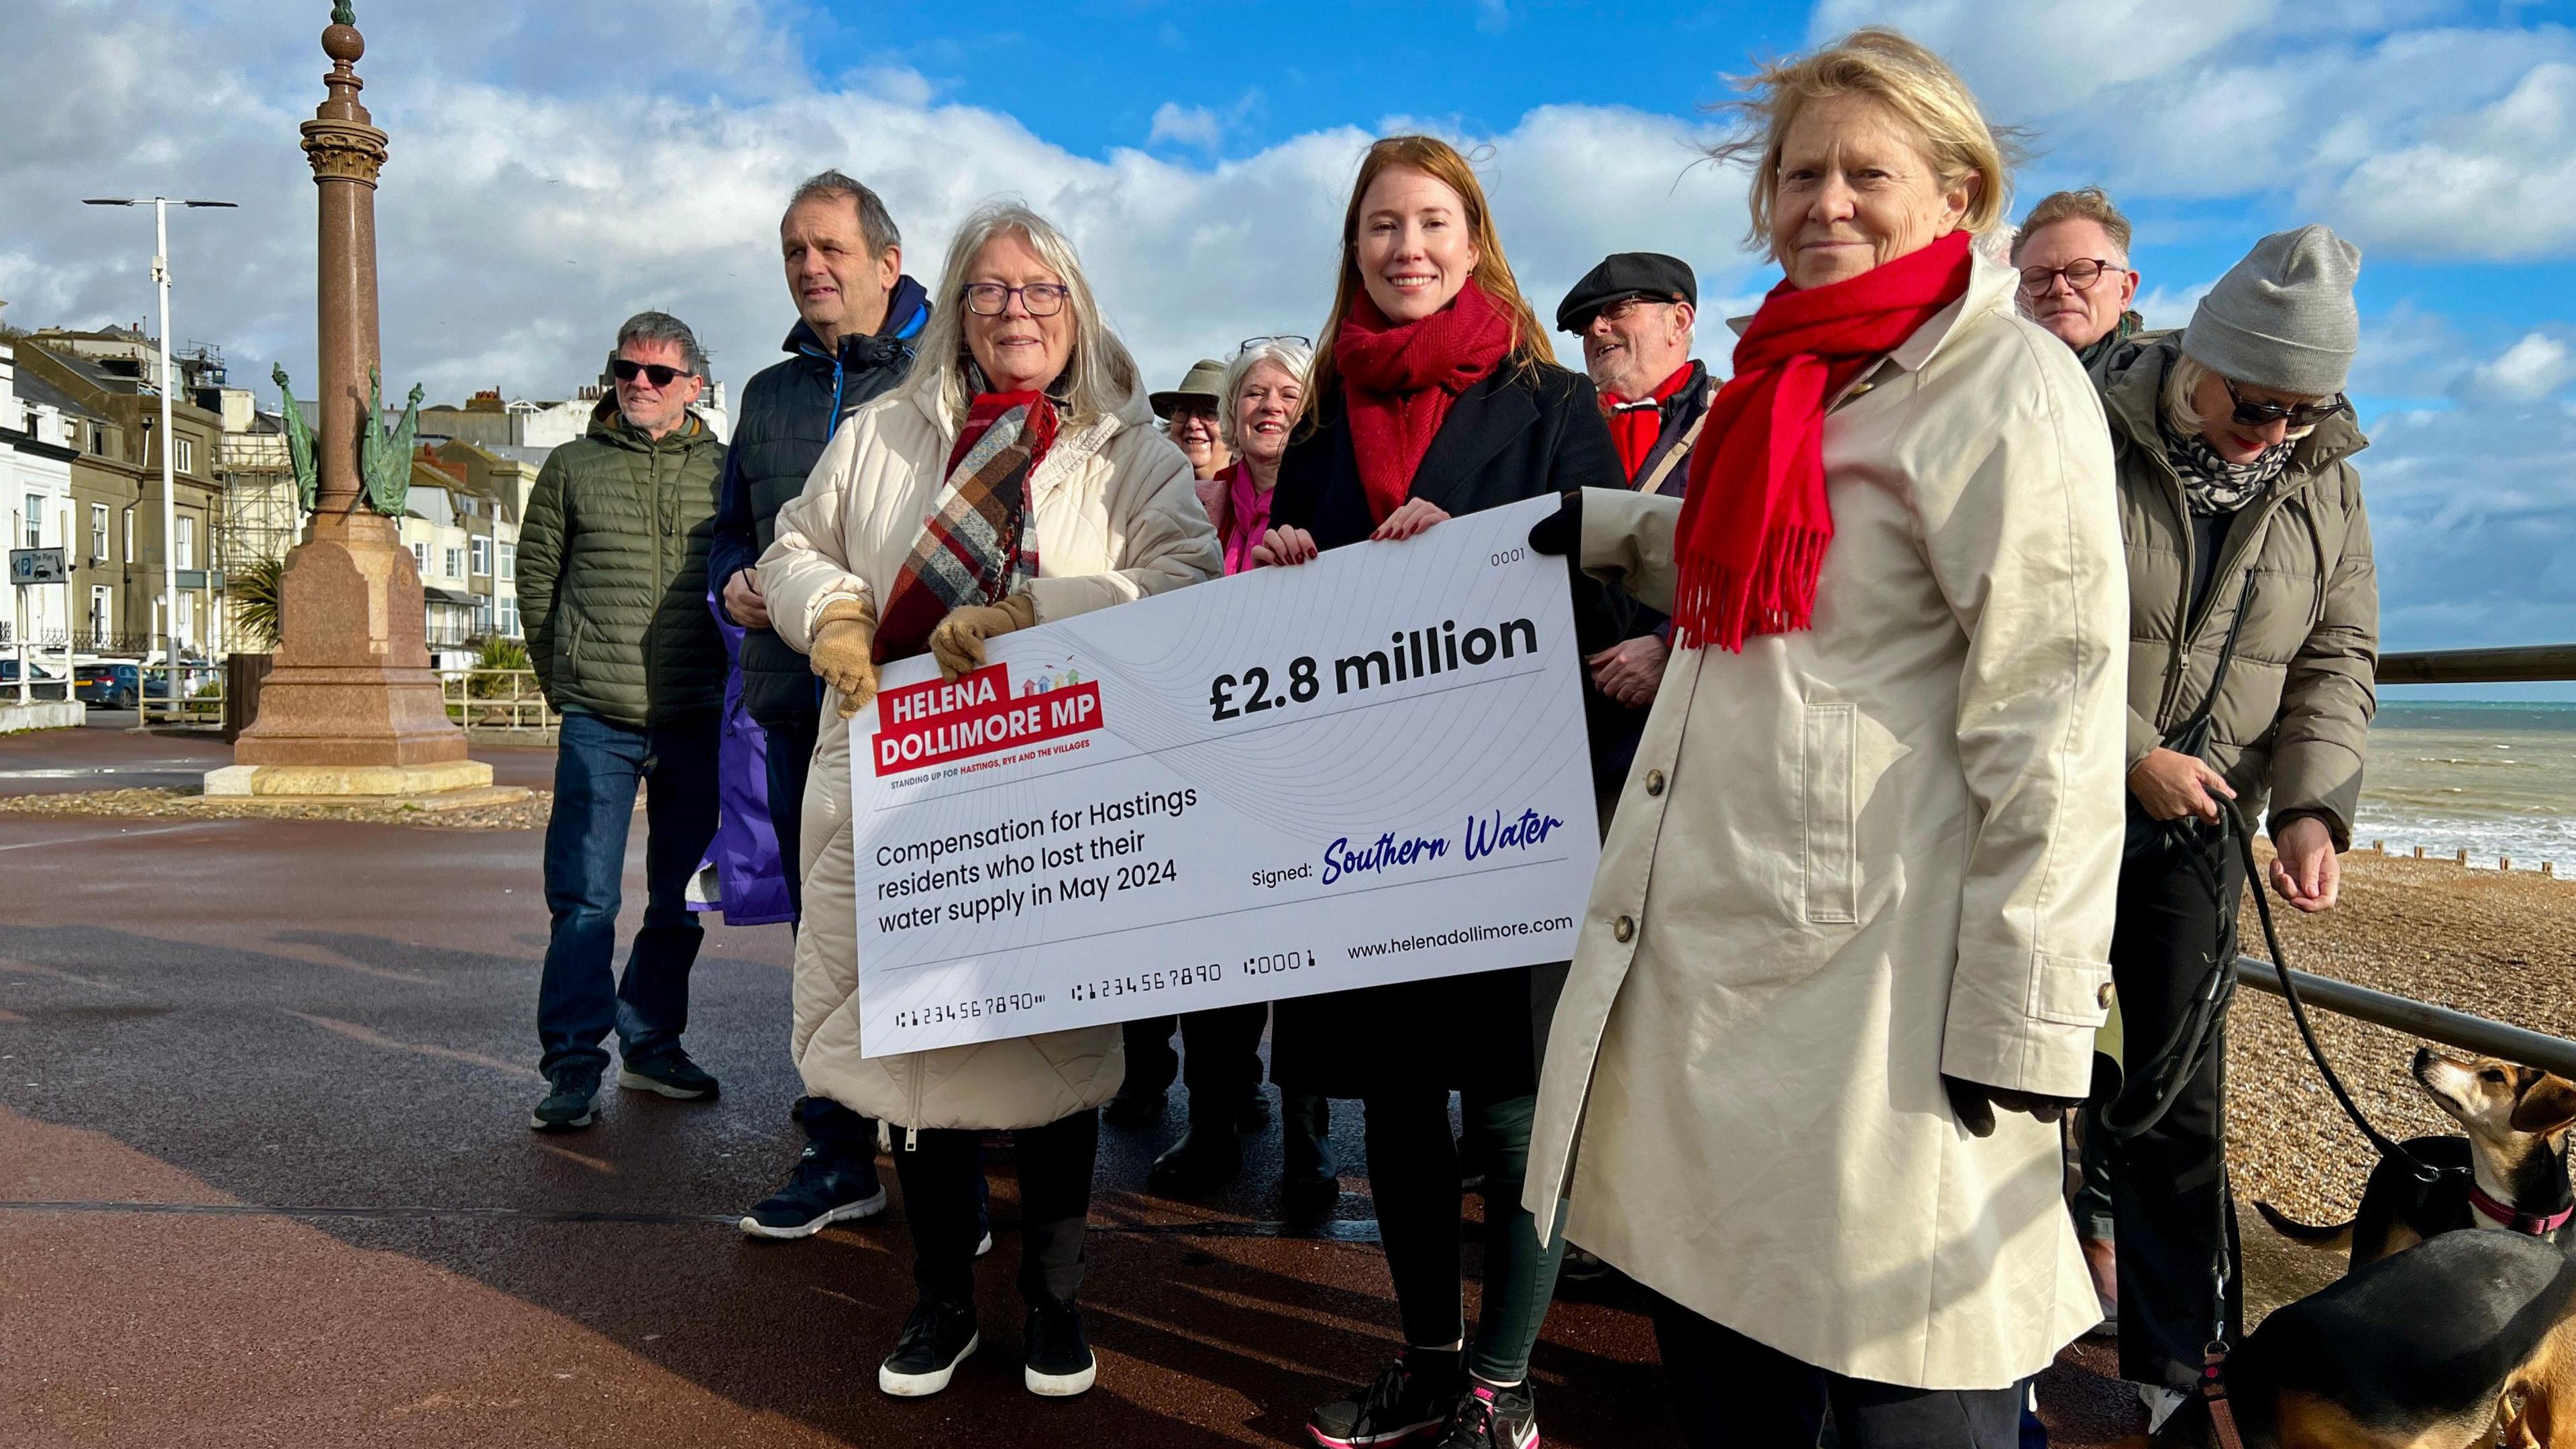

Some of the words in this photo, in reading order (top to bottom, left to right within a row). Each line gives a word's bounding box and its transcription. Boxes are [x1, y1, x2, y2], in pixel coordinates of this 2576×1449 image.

[1490, 547, 1525, 568] 0001
[892, 676, 998, 725] HELENA
[1209, 655, 1320, 722] £2.8
[1334, 618, 1539, 696] million
[881, 704, 1042, 767] DOLLIMORE
[1050, 694, 1096, 730] MP
[891, 774, 929, 790] STANDING
[931, 771, 941, 781] UP
[943, 768, 959, 778] FOR
[960, 758, 1002, 775] HASTINGS,
[1002, 755, 1017, 766] RYE
[1018, 751, 1036, 763] AND
[1037, 747, 1052, 758] THE
[1053, 739, 1090, 754] VILLAGES
[876, 818, 1044, 867] Compensation
[1051, 809, 1083, 834] for
[1089, 786, 1198, 826] Hastings
[1251, 861, 1313, 889] Signed:
[1322, 830, 1451, 886] Southern
[1464, 807, 1565, 861] Water
[877, 863, 981, 900] residents
[985, 853, 1035, 880] who
[1041, 842, 1084, 870] lost
[1089, 829, 1146, 861] their
[878, 902, 943, 934] water
[948, 887, 1026, 924] supply
[1030, 883, 1053, 906] in
[1059, 873, 1111, 902] May
[1116, 859, 1178, 892] 2024
[1346, 915, 1574, 960] www.helenadollimore.com
[1473, 1387, 1494, 1401] NIKE
